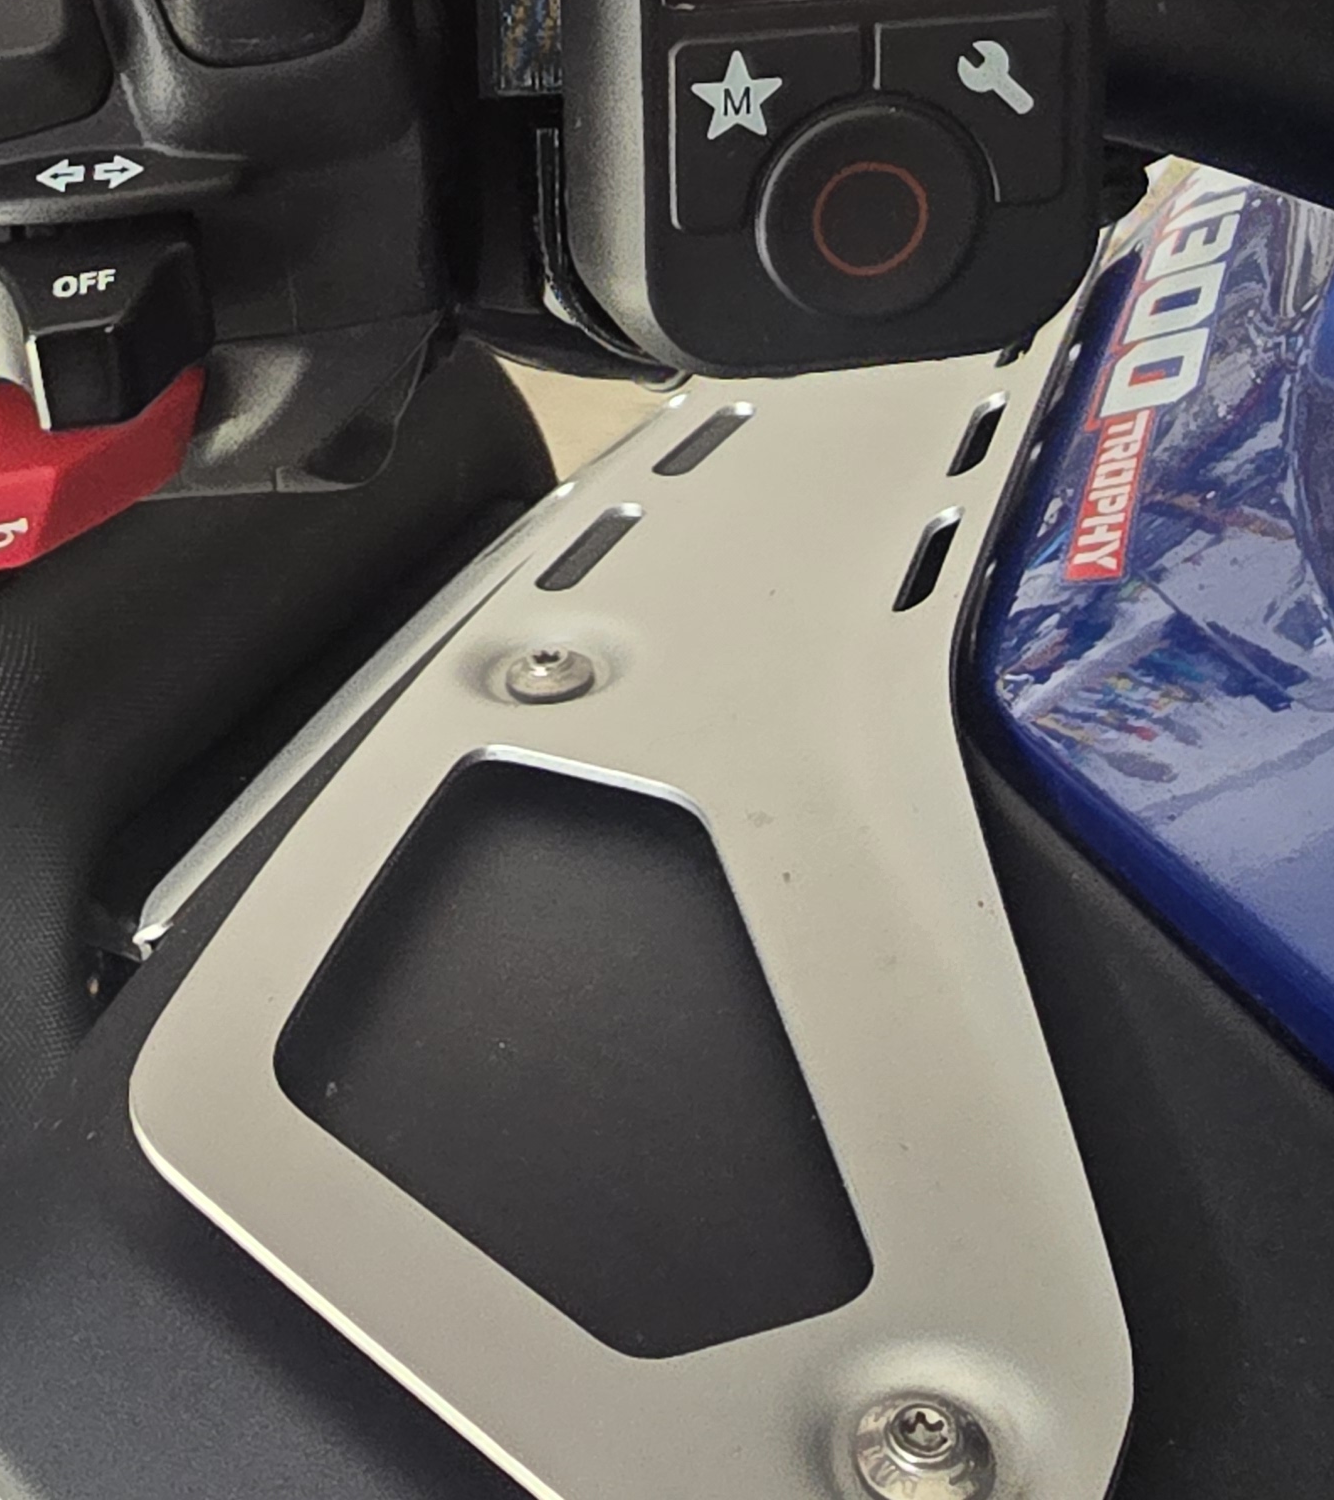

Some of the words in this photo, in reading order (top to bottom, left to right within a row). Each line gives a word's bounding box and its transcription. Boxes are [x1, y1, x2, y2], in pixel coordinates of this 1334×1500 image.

[723, 86, 750, 117] M
[52, 268, 116, 298] OFF
[1073, 409, 1151, 571] TROPHY
